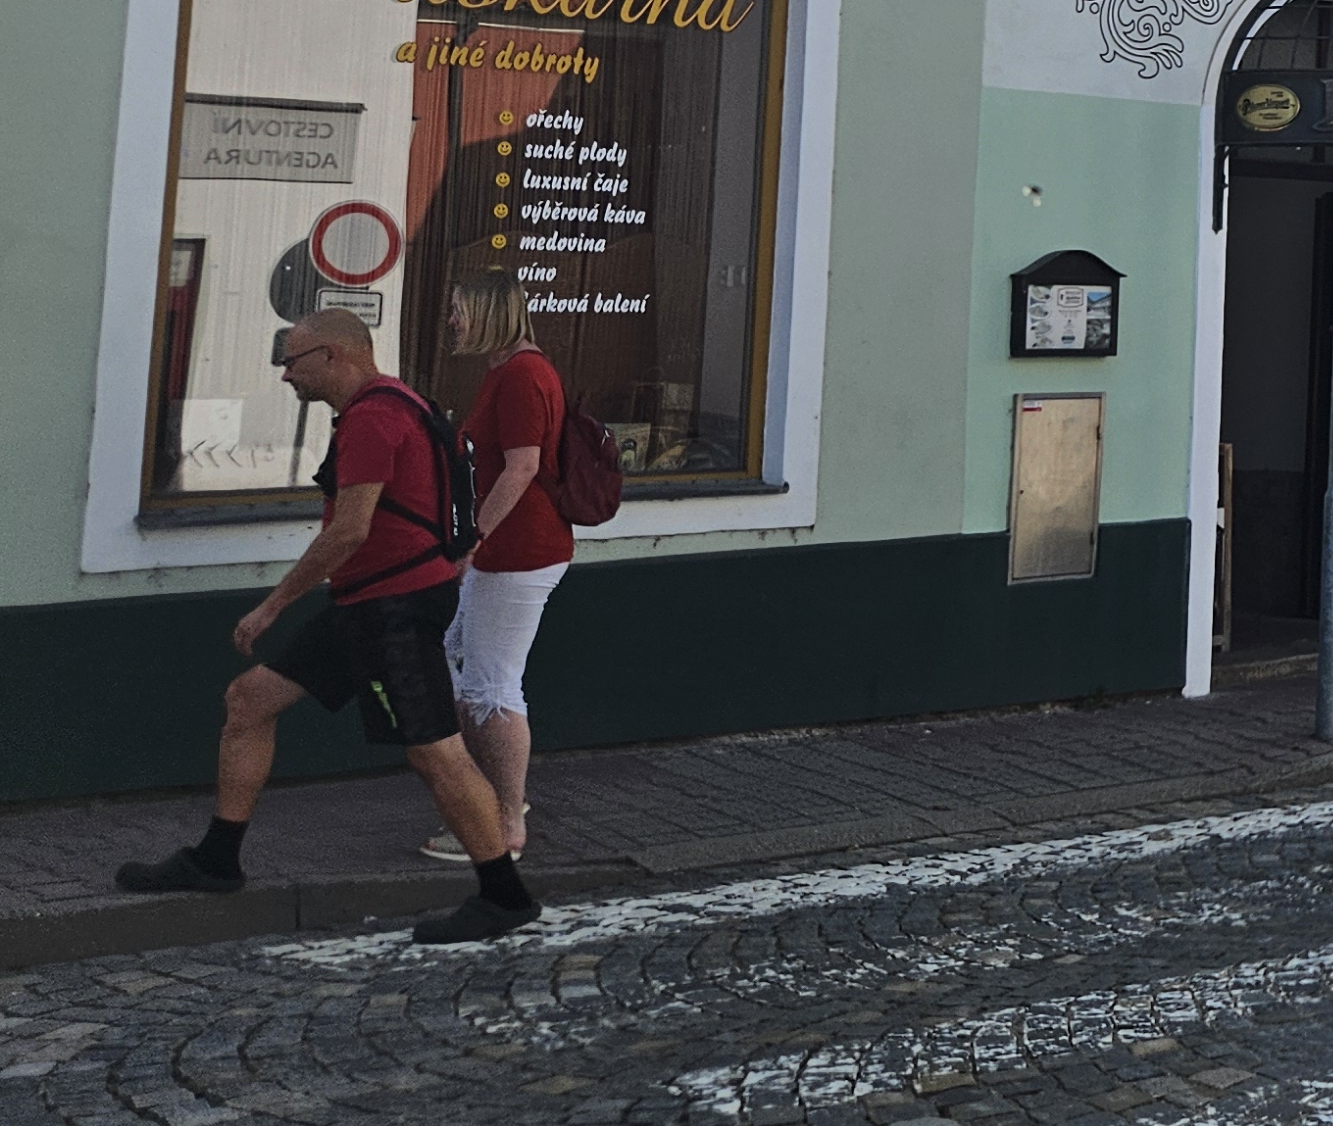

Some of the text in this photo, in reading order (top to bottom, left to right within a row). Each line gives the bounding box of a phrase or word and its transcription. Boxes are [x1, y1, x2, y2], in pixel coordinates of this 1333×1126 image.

[395, 36, 600, 84] a jiné dobroty
[526, 109, 584, 135] ořechy
[524, 139, 627, 167] suché plody
[523, 168, 629, 196] luxusní čaje
[521, 200, 647, 224] výběrová káva
[519, 231, 607, 252] medovina
[517, 262, 557, 282] víno
[594, 292, 651, 313] balení
